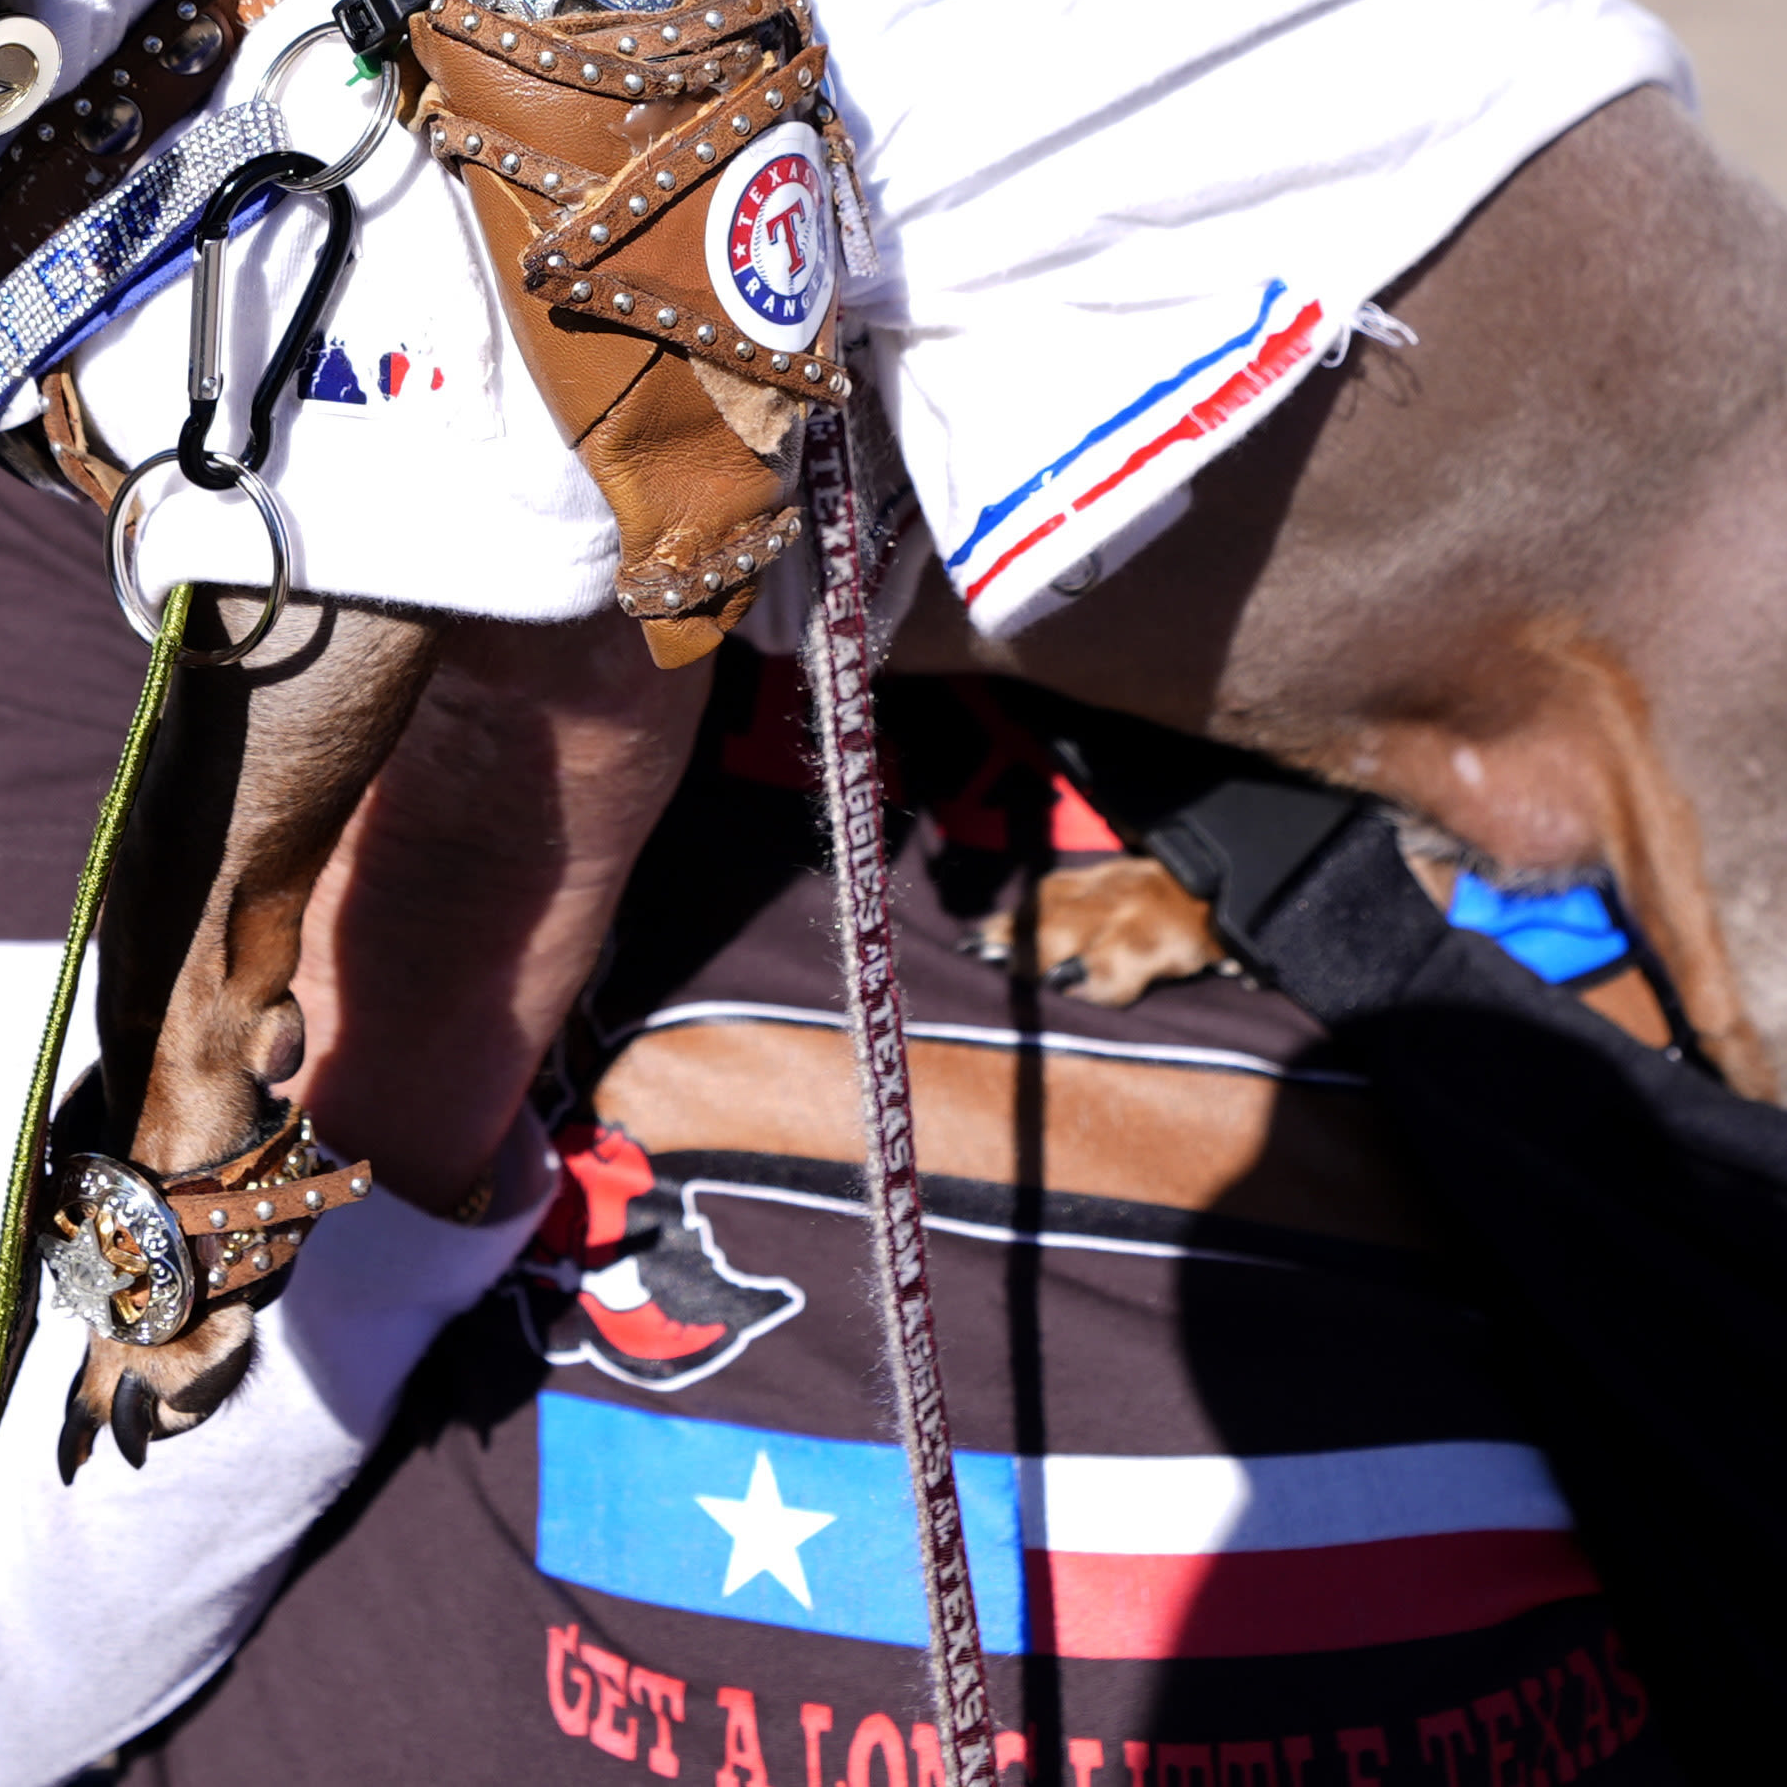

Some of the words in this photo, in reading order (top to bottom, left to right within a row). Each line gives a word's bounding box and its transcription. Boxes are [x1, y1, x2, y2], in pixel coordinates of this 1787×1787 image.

[736, 160, 814, 228] TEXAS
[766, 197, 807, 280] T
[809, 445, 859, 623] TEXAS
[838, 748, 886, 934] AGGIES
[866, 992, 912, 1172] TEXAS
[547, 1623, 687, 1779] GET
[716, 1686, 770, 1787] A
